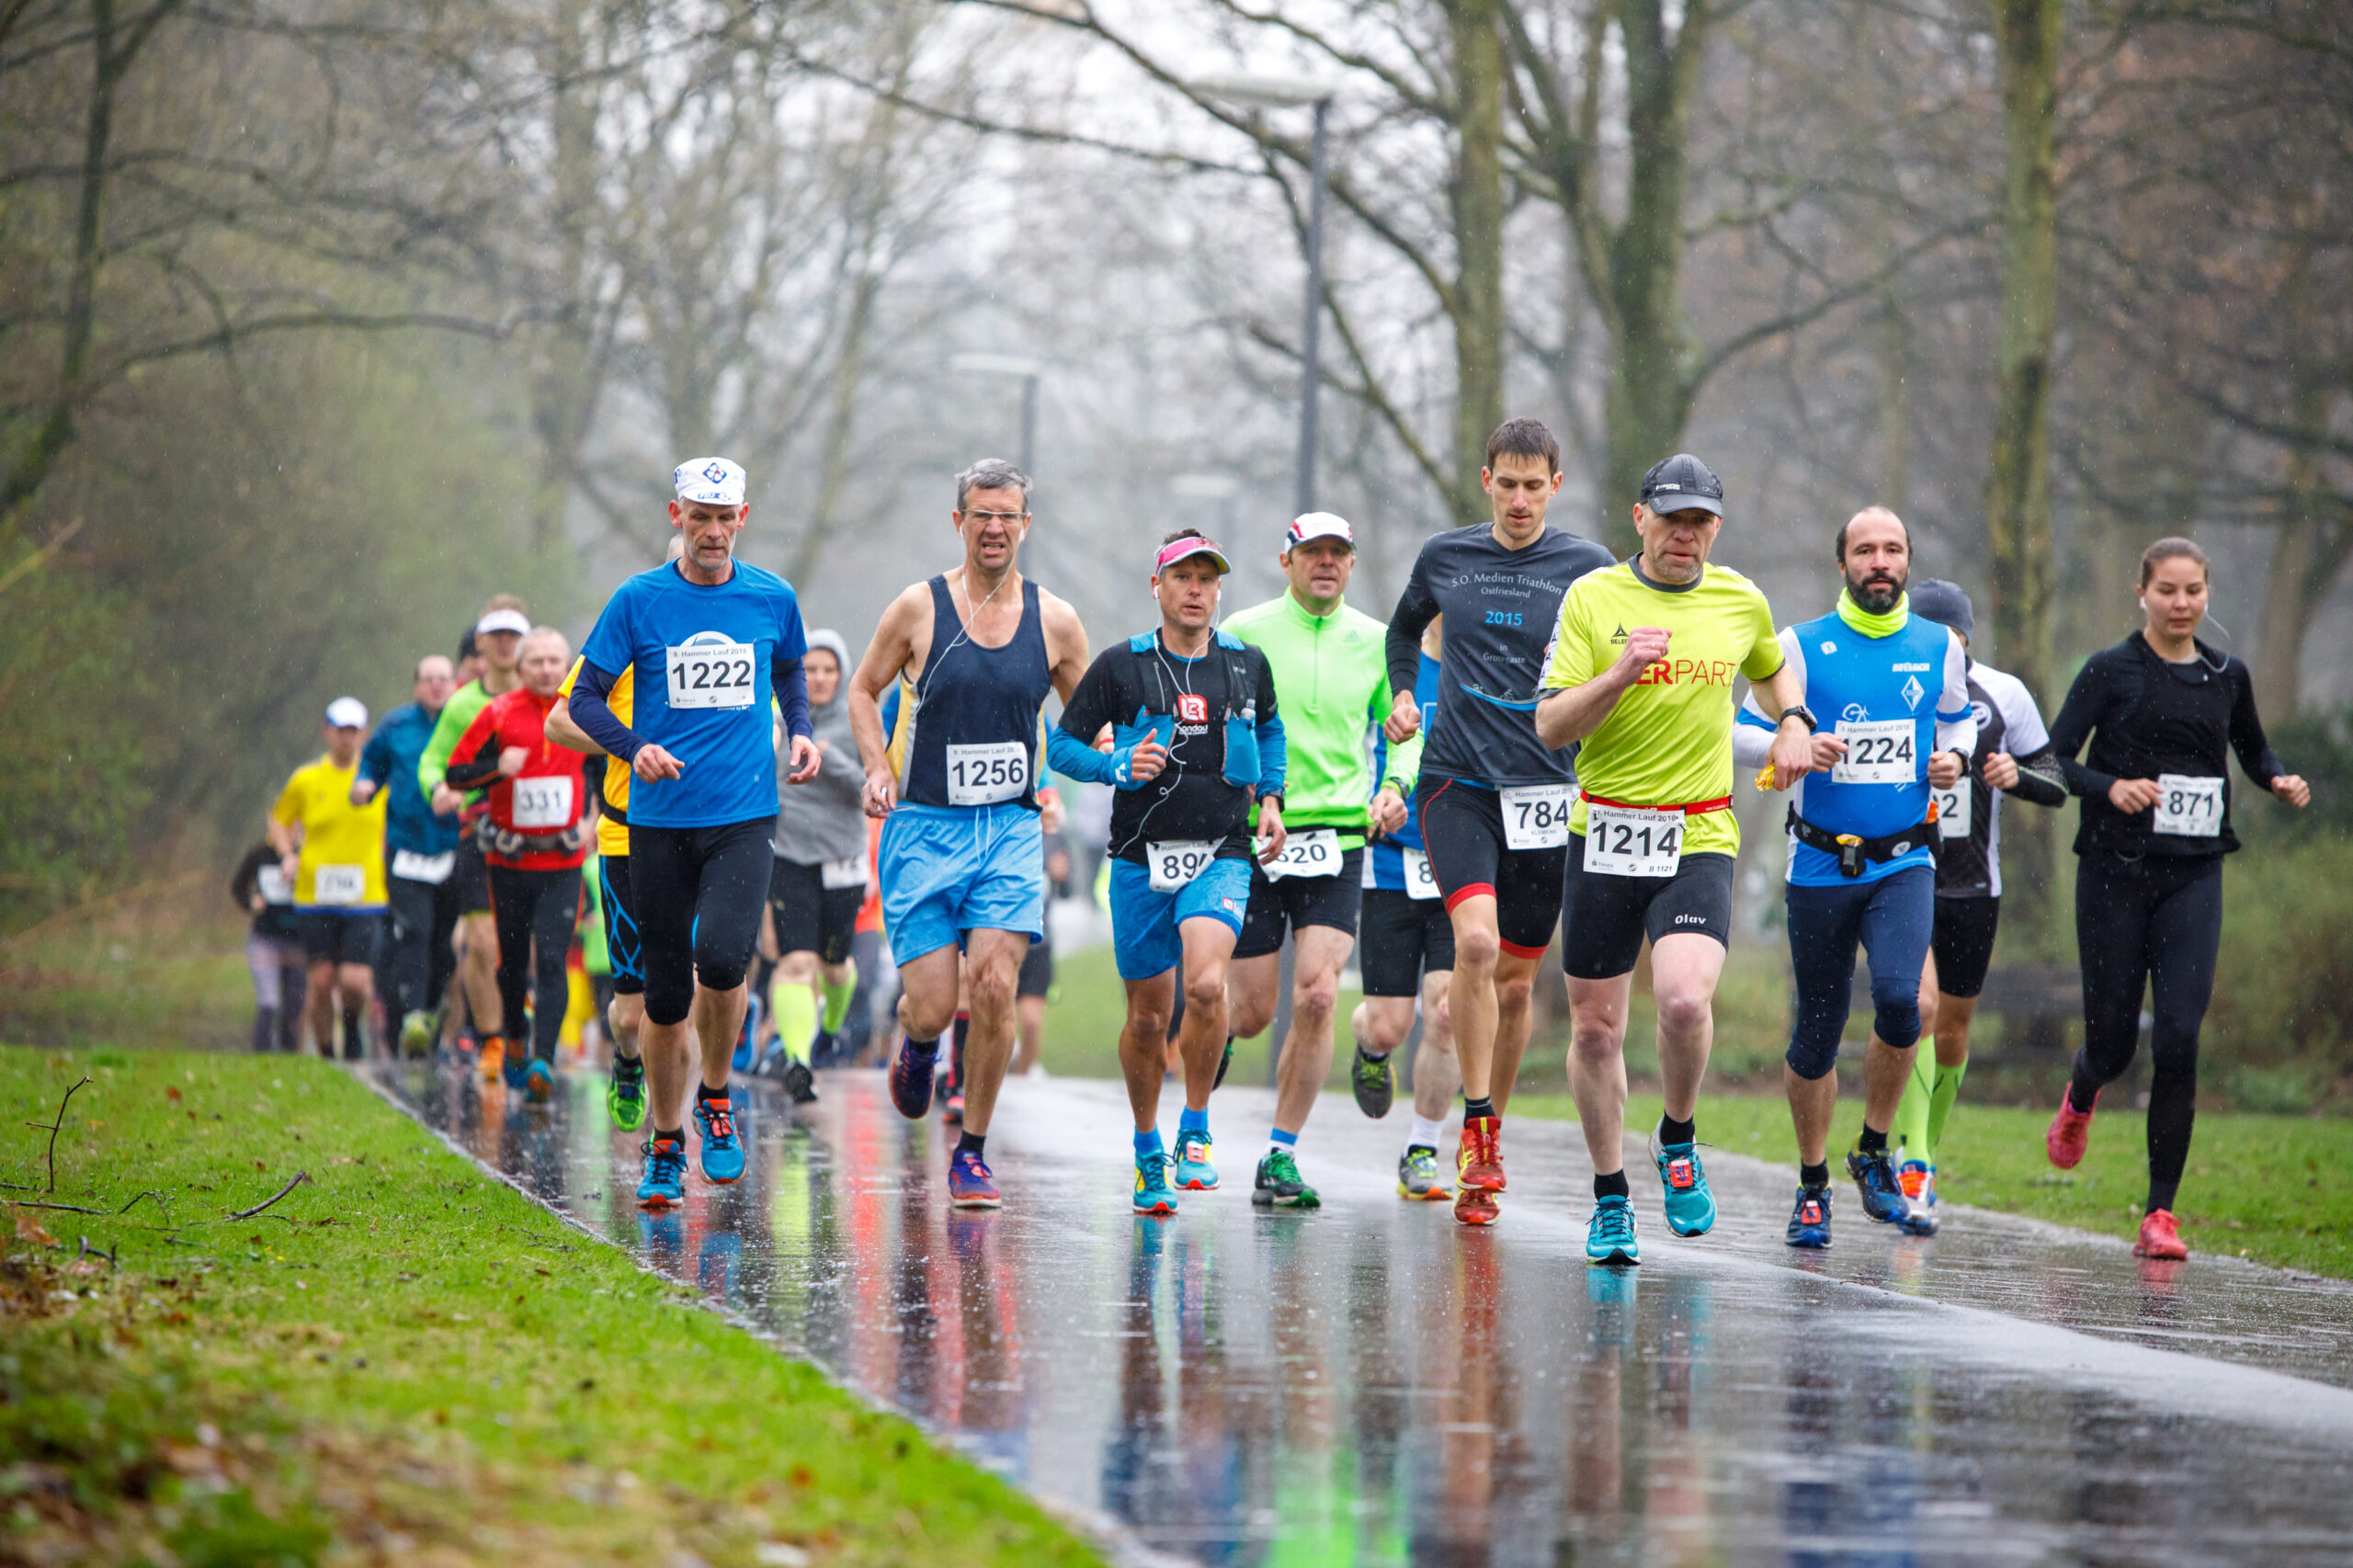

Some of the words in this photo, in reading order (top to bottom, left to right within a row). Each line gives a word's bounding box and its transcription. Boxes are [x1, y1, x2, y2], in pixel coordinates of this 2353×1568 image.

[1452, 574, 1472, 587] S.O.
[1474, 573, 1514, 584] Medien
[1517, 574, 1563, 596] Triathlon
[1481, 587, 1531, 598] Ostfriesland
[1484, 610, 1523, 626] 2015
[681, 649, 711, 657] Hammer
[713, 648, 729, 656] Lauf
[673, 659, 751, 690] 1222
[1842, 735, 1914, 765] 1224
[952, 757, 1024, 787] 1256
[521, 790, 562, 812] 331
[1515, 790, 1545, 798] Hammer
[1546, 788, 1561, 796] Lauf
[2169, 790, 2214, 817] 871
[1514, 799, 1569, 829] 784
[1604, 809, 1637, 820] Hammer
[1638, 812, 1655, 822] Lauf
[1658, 814, 1677, 823] 2018
[1161, 842, 1191, 852] Hammer
[1592, 821, 1677, 858] 1214
[1656, 865, 1673, 873] 1121
[1675, 913, 1707, 925] Olav
